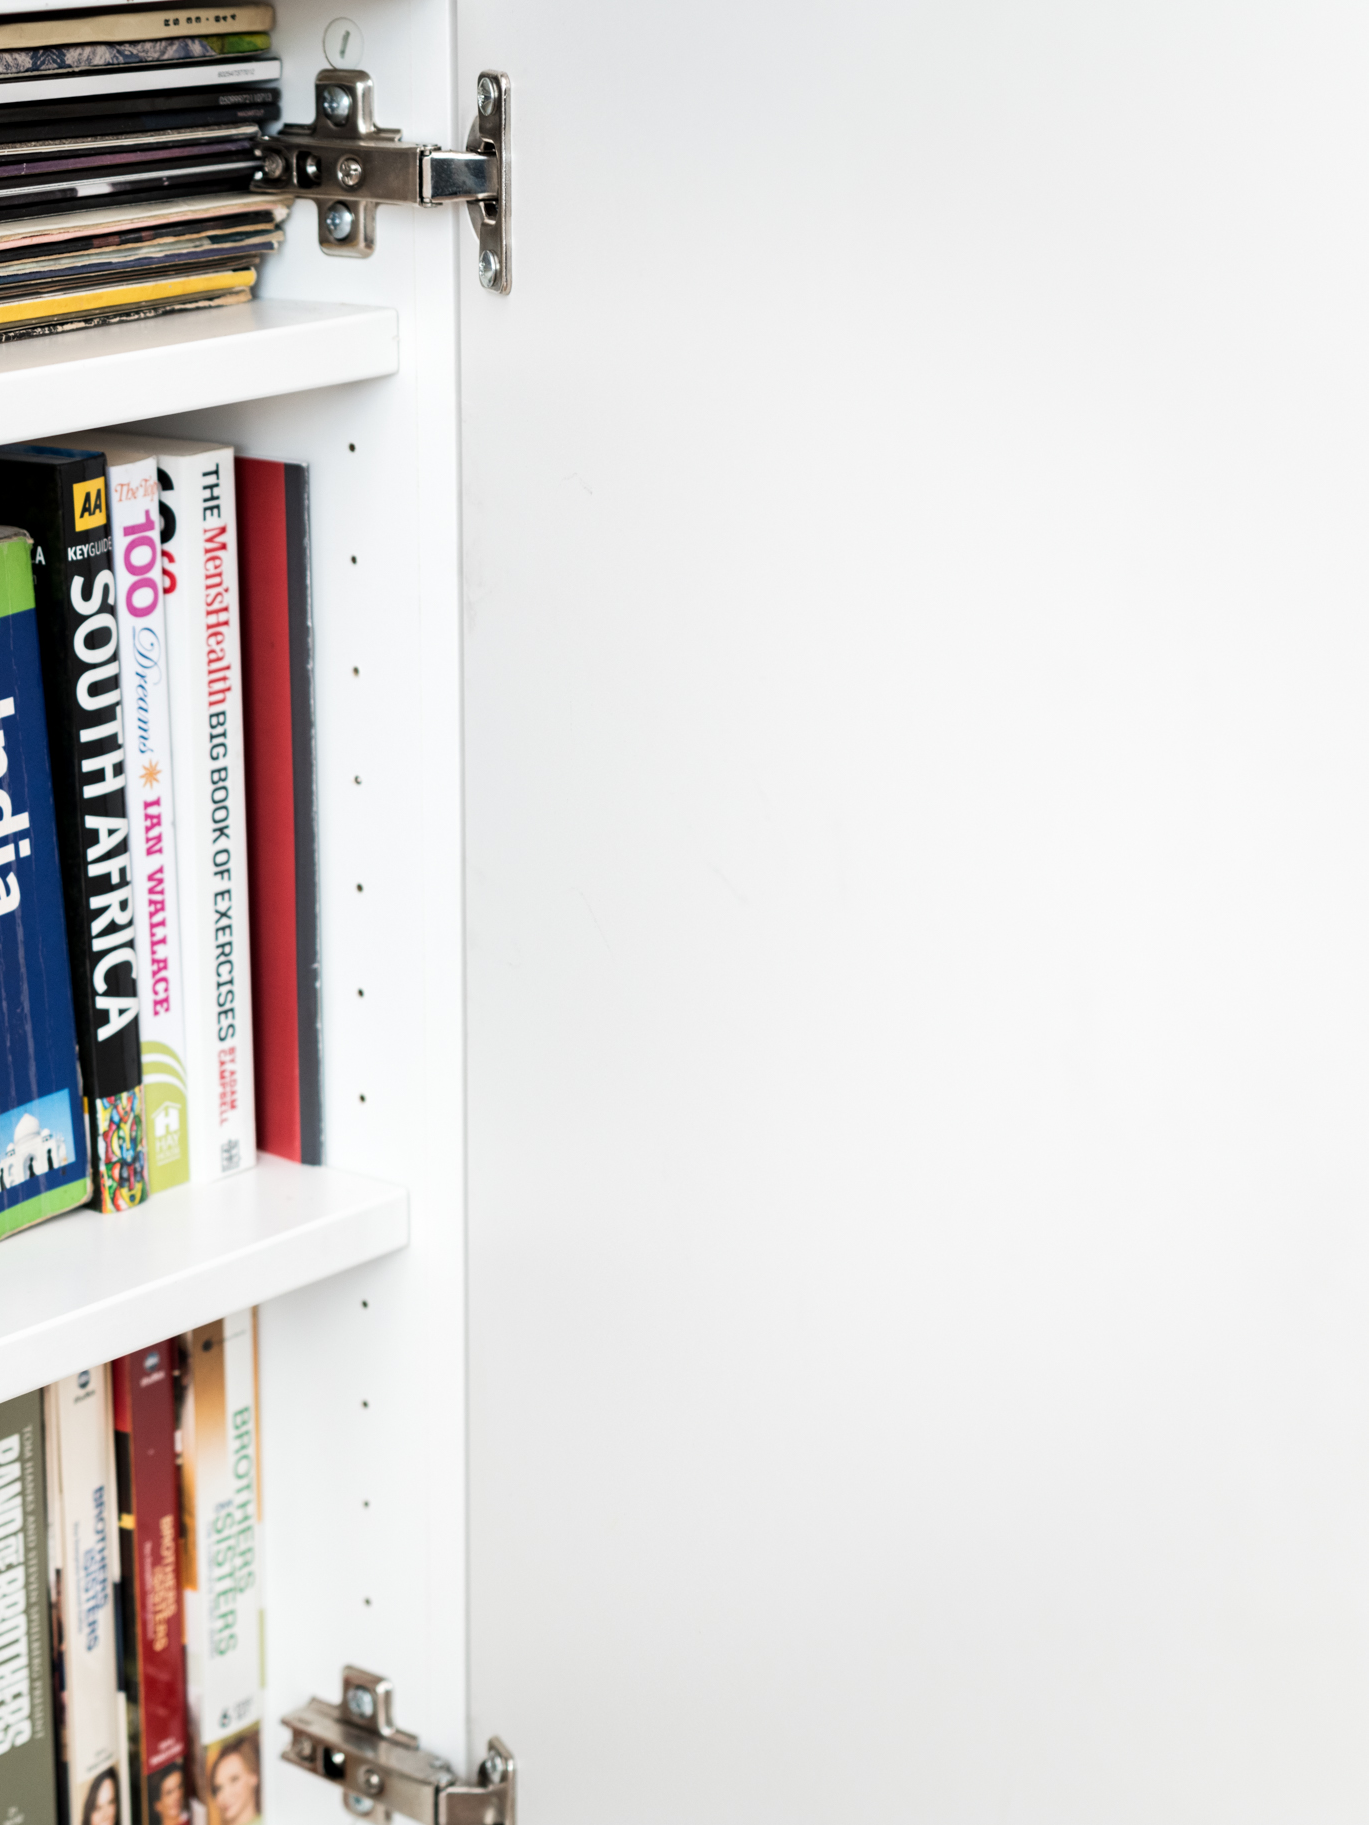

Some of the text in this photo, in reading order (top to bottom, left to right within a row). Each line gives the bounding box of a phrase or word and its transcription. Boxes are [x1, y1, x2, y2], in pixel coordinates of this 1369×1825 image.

[79, 488, 103, 519] AA
[114, 482, 138, 503] The
[201, 463, 222, 522] THE
[123, 508, 170, 1017] 100 Dreams IAN WALLACE
[209, 710, 228, 761] BIG
[69, 568, 140, 1042] SOUTH AFRICA
[210, 766, 230, 845] BOOK
[212, 848, 231, 882] OF
[213, 888, 236, 1043] EXERCISES
[228, 1070, 238, 1110] ADAM
[212, 1406, 255, 1656] BROTHERS SISTERS
